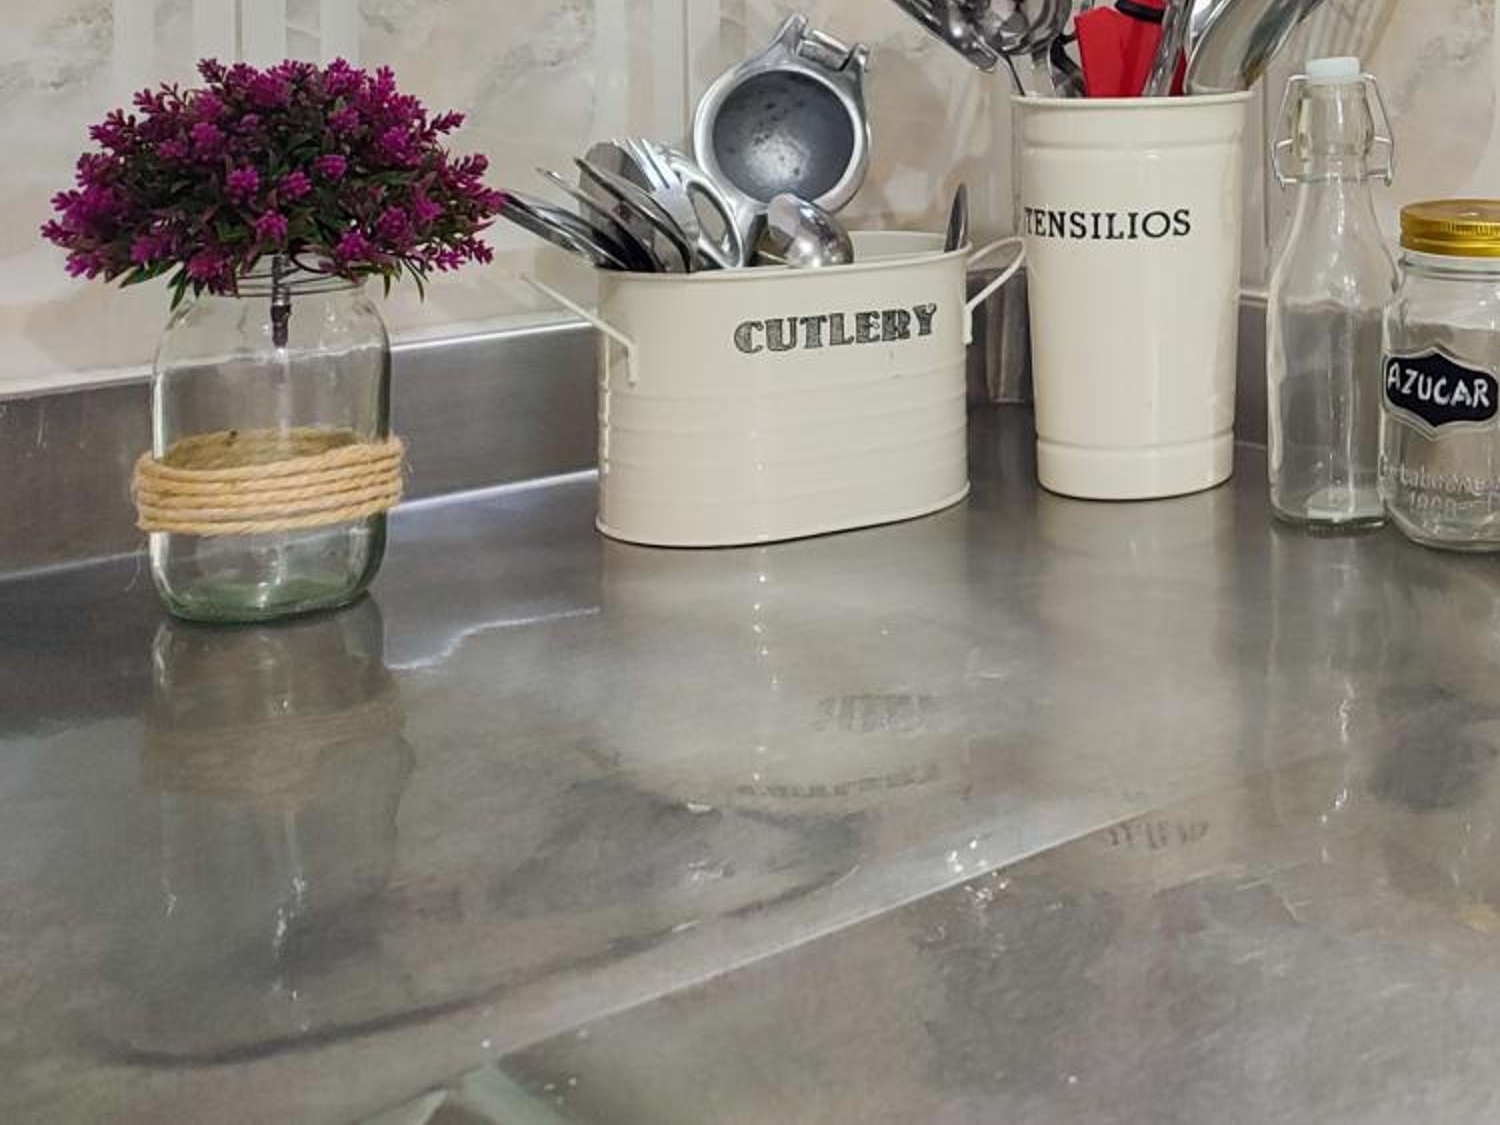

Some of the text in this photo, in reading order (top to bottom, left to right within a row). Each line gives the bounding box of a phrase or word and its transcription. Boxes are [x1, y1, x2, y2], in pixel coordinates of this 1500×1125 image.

[1023, 206, 1191, 239] TENSILIOS
[734, 303, 937, 353] CUTLERY
[1387, 362, 1491, 409] AZUCAR
